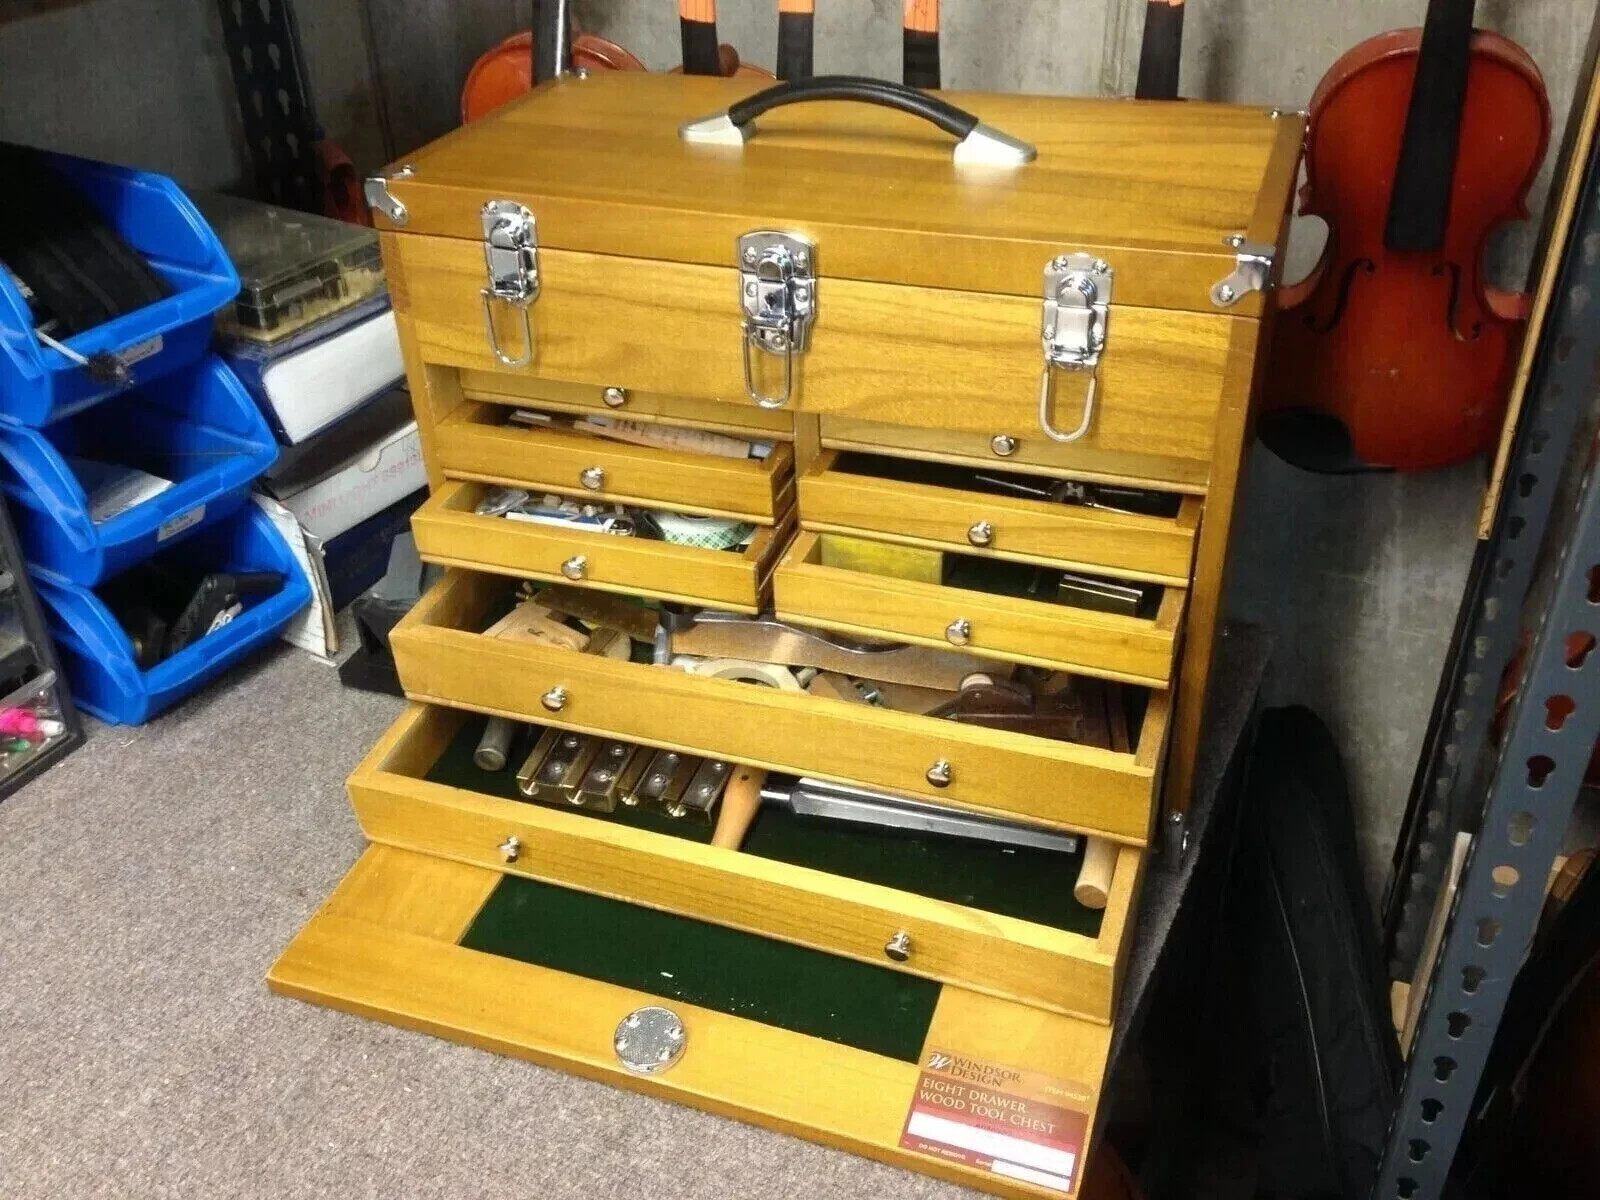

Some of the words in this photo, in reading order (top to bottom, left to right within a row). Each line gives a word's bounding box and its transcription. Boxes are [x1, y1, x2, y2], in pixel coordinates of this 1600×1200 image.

[950, 1066, 1004, 1088] DESIGN
[953, 1055, 1022, 1082] WINDSOR
[920, 1089, 966, 1110] WOOD
[969, 1102, 1007, 1122] TOOL
[1009, 1112, 1057, 1134] CHEST
[922, 1077, 966, 1097] EIGHT
[968, 1089, 1027, 1114] DRAWER
